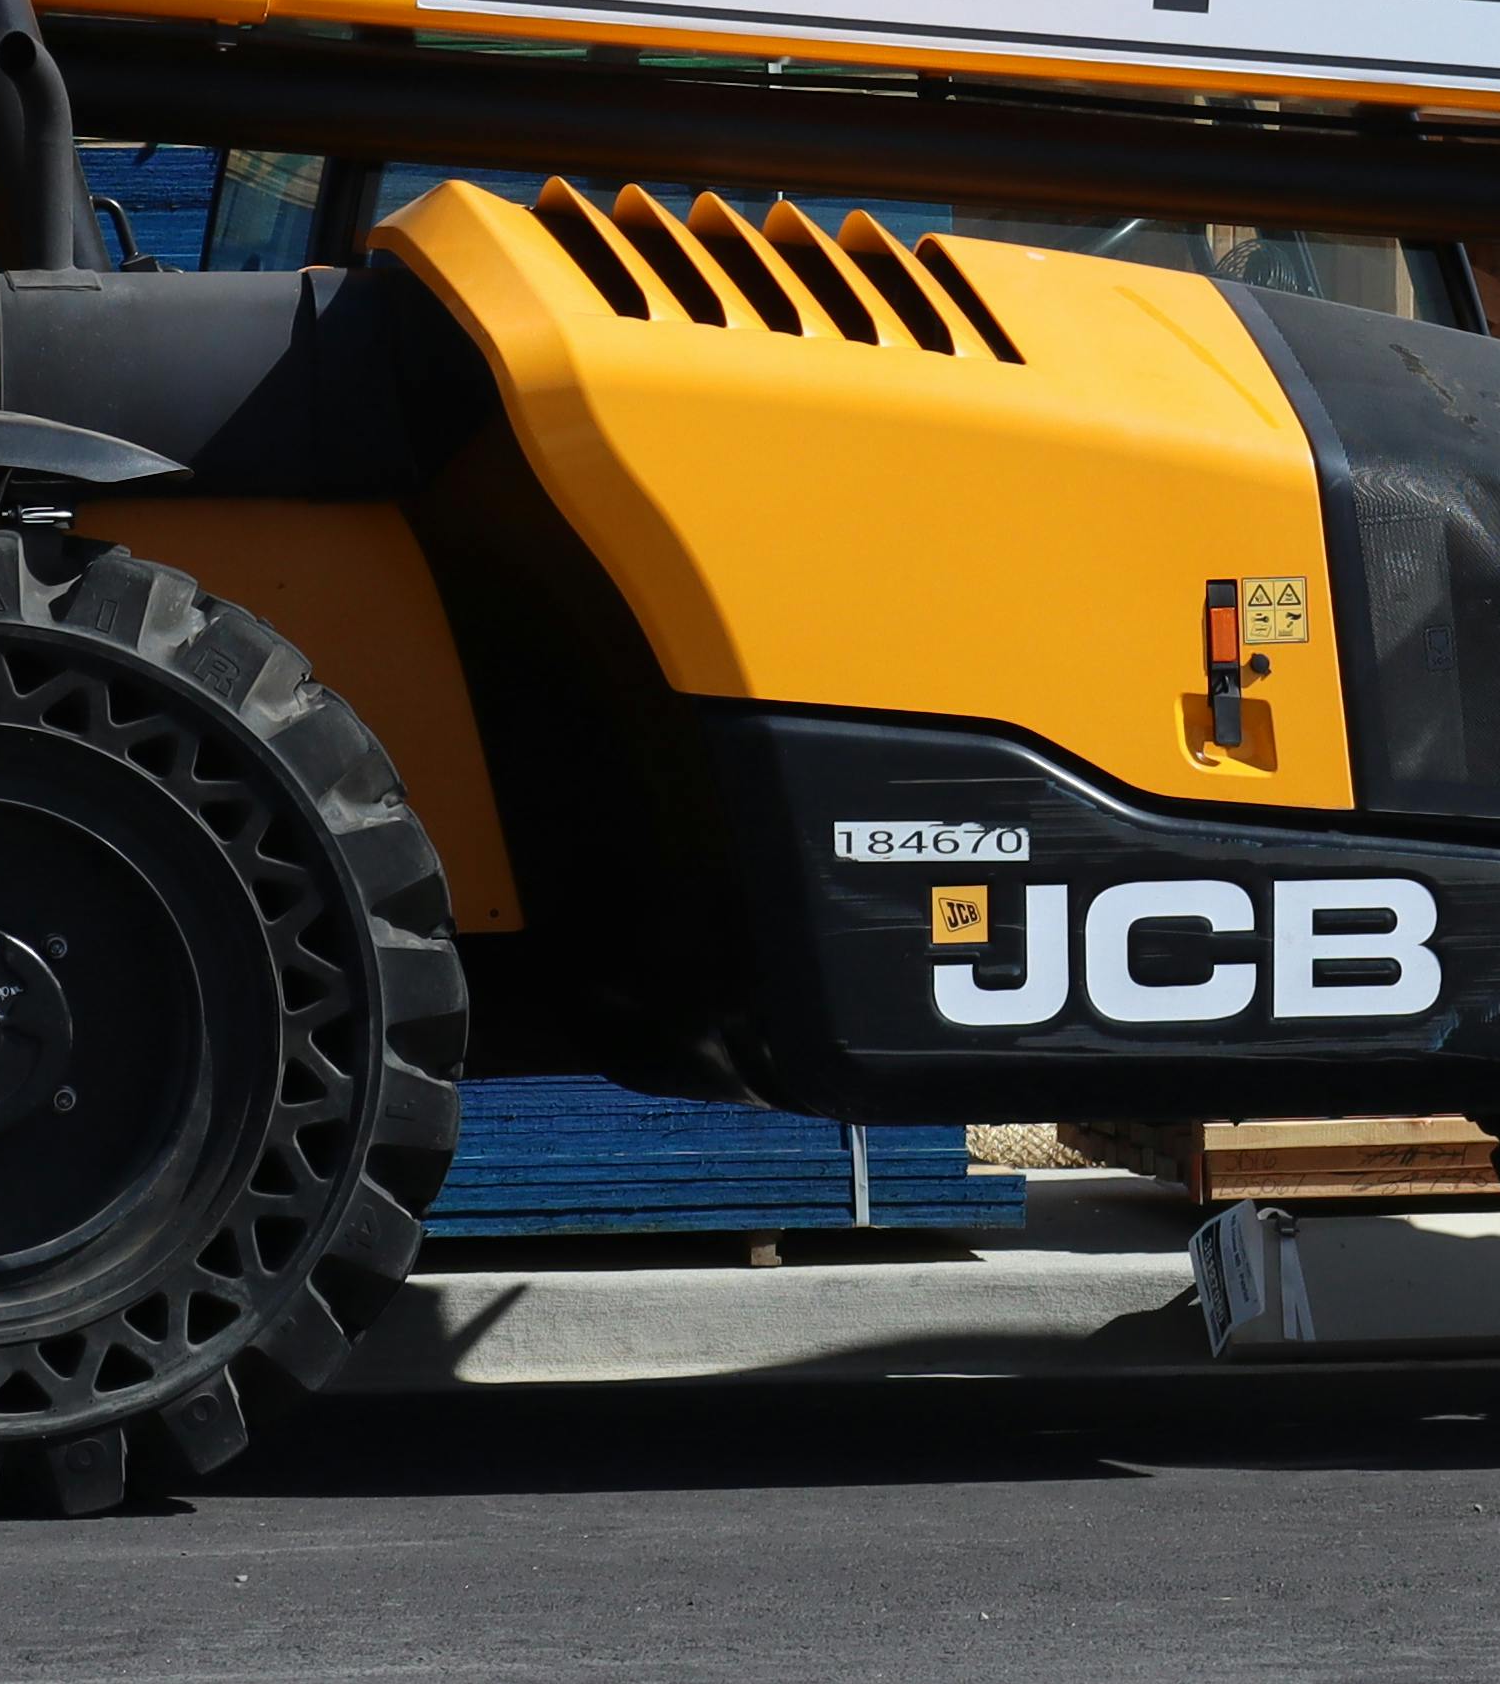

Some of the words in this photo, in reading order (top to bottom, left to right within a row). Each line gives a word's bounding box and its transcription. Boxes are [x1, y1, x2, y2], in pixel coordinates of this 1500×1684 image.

[838, 829, 1023, 855] 184670
[945, 900, 978, 928] JCB
[933, 878, 1442, 1025] JCB
